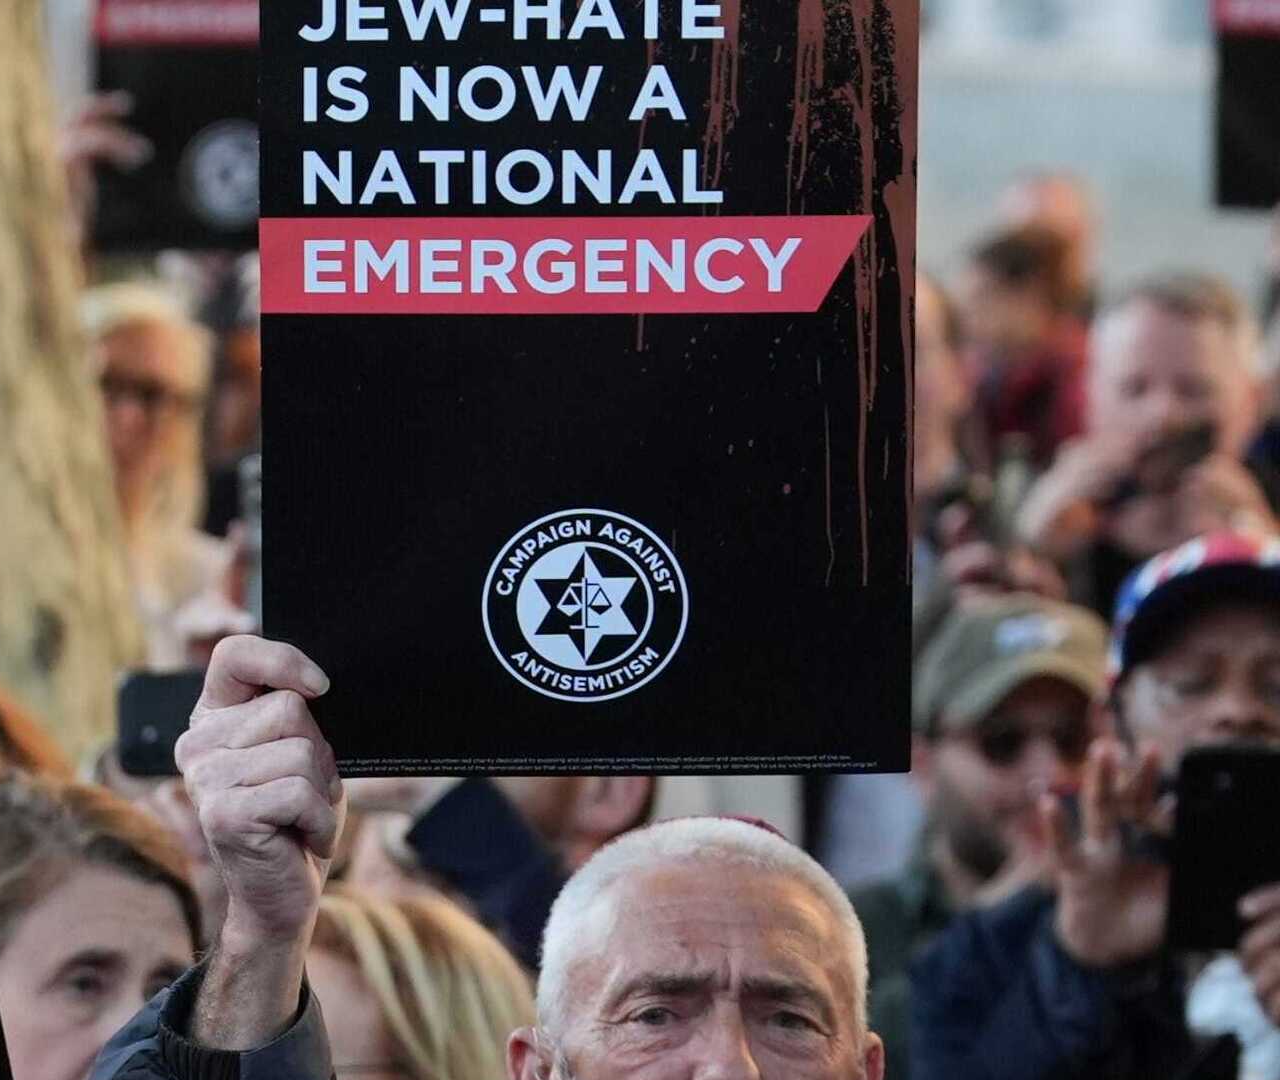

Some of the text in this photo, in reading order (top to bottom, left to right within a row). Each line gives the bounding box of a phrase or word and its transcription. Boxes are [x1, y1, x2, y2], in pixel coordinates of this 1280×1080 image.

[298, 0, 725, 42] JEW-HATE
[302, 65, 687, 122] IS NOW A
[302, 149, 724, 206] NATIONAL
[303, 236, 802, 295] EMERGENCY
[496, 519, 676, 596] CAMPAIGN AGAINST
[510, 646, 660, 692] ANTISEMITISM
